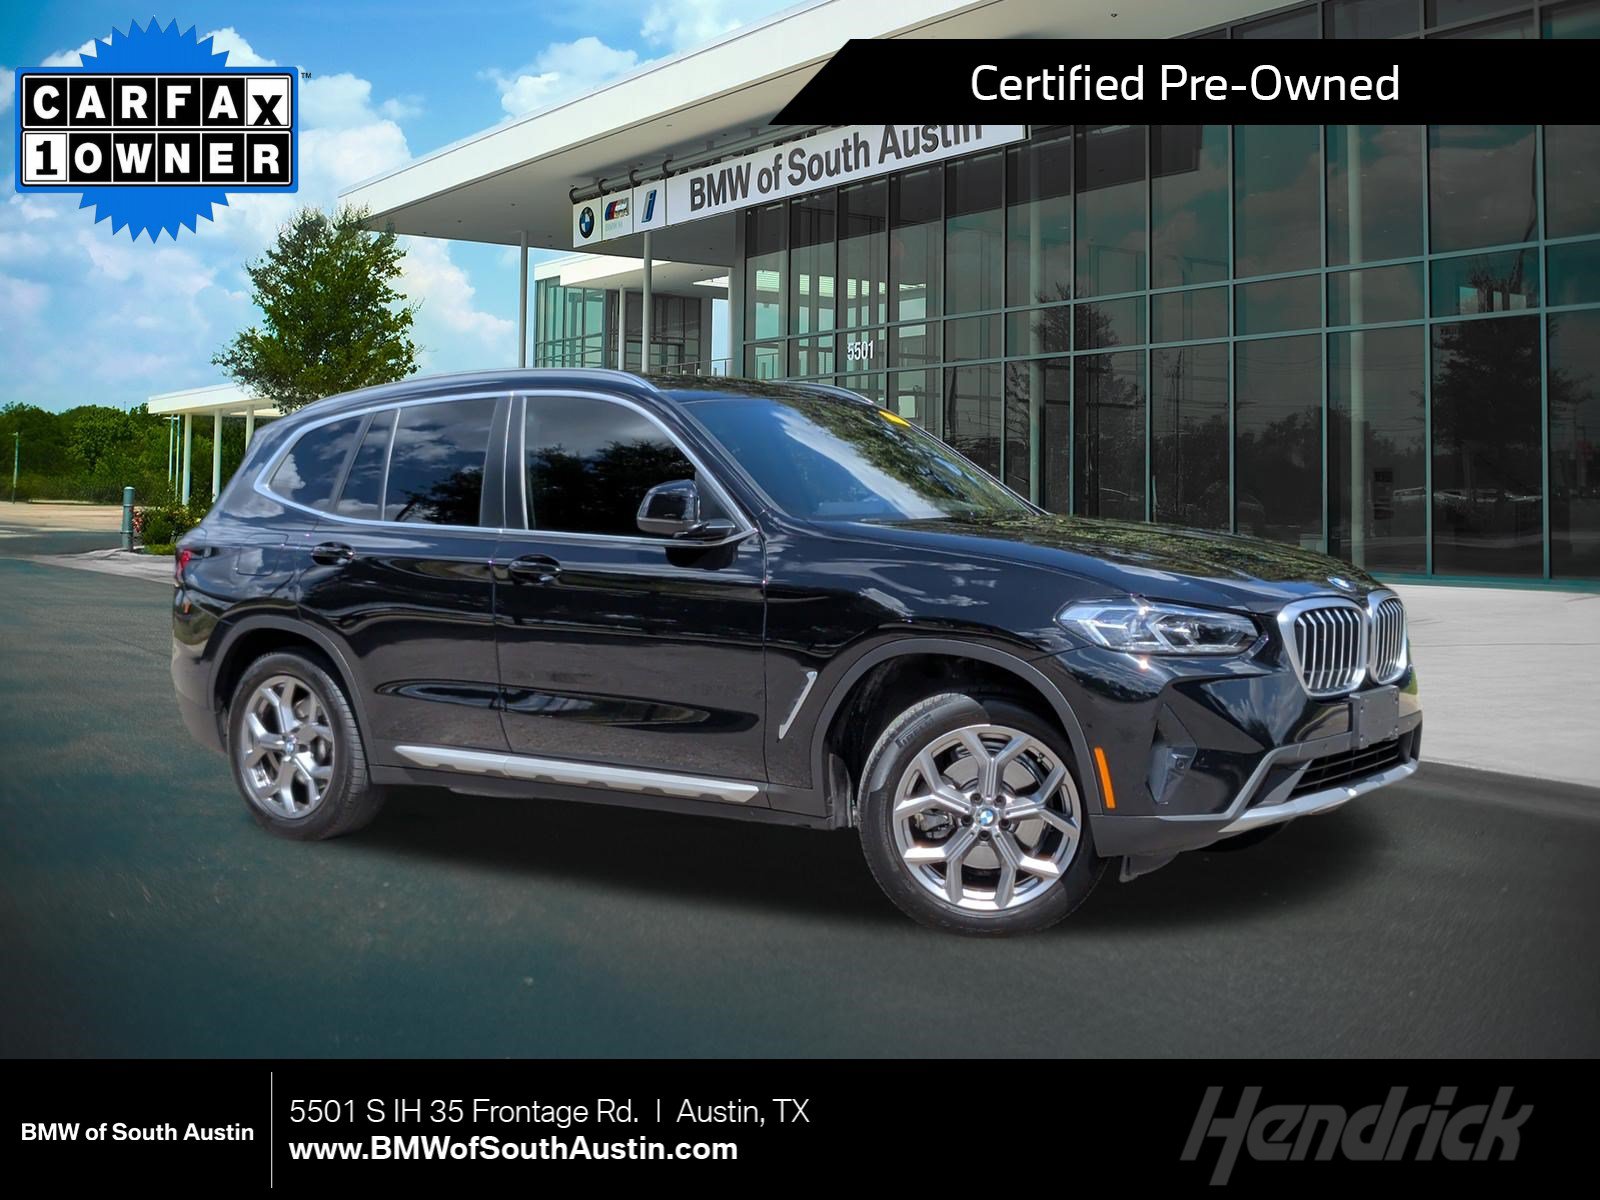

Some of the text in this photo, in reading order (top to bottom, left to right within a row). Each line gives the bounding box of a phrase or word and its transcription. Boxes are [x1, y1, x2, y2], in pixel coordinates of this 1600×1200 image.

[690, 162, 751, 212] BMW
[757, 153, 783, 194] of
[787, 132, 870, 186] South
[847, 340, 874, 360] 5501
